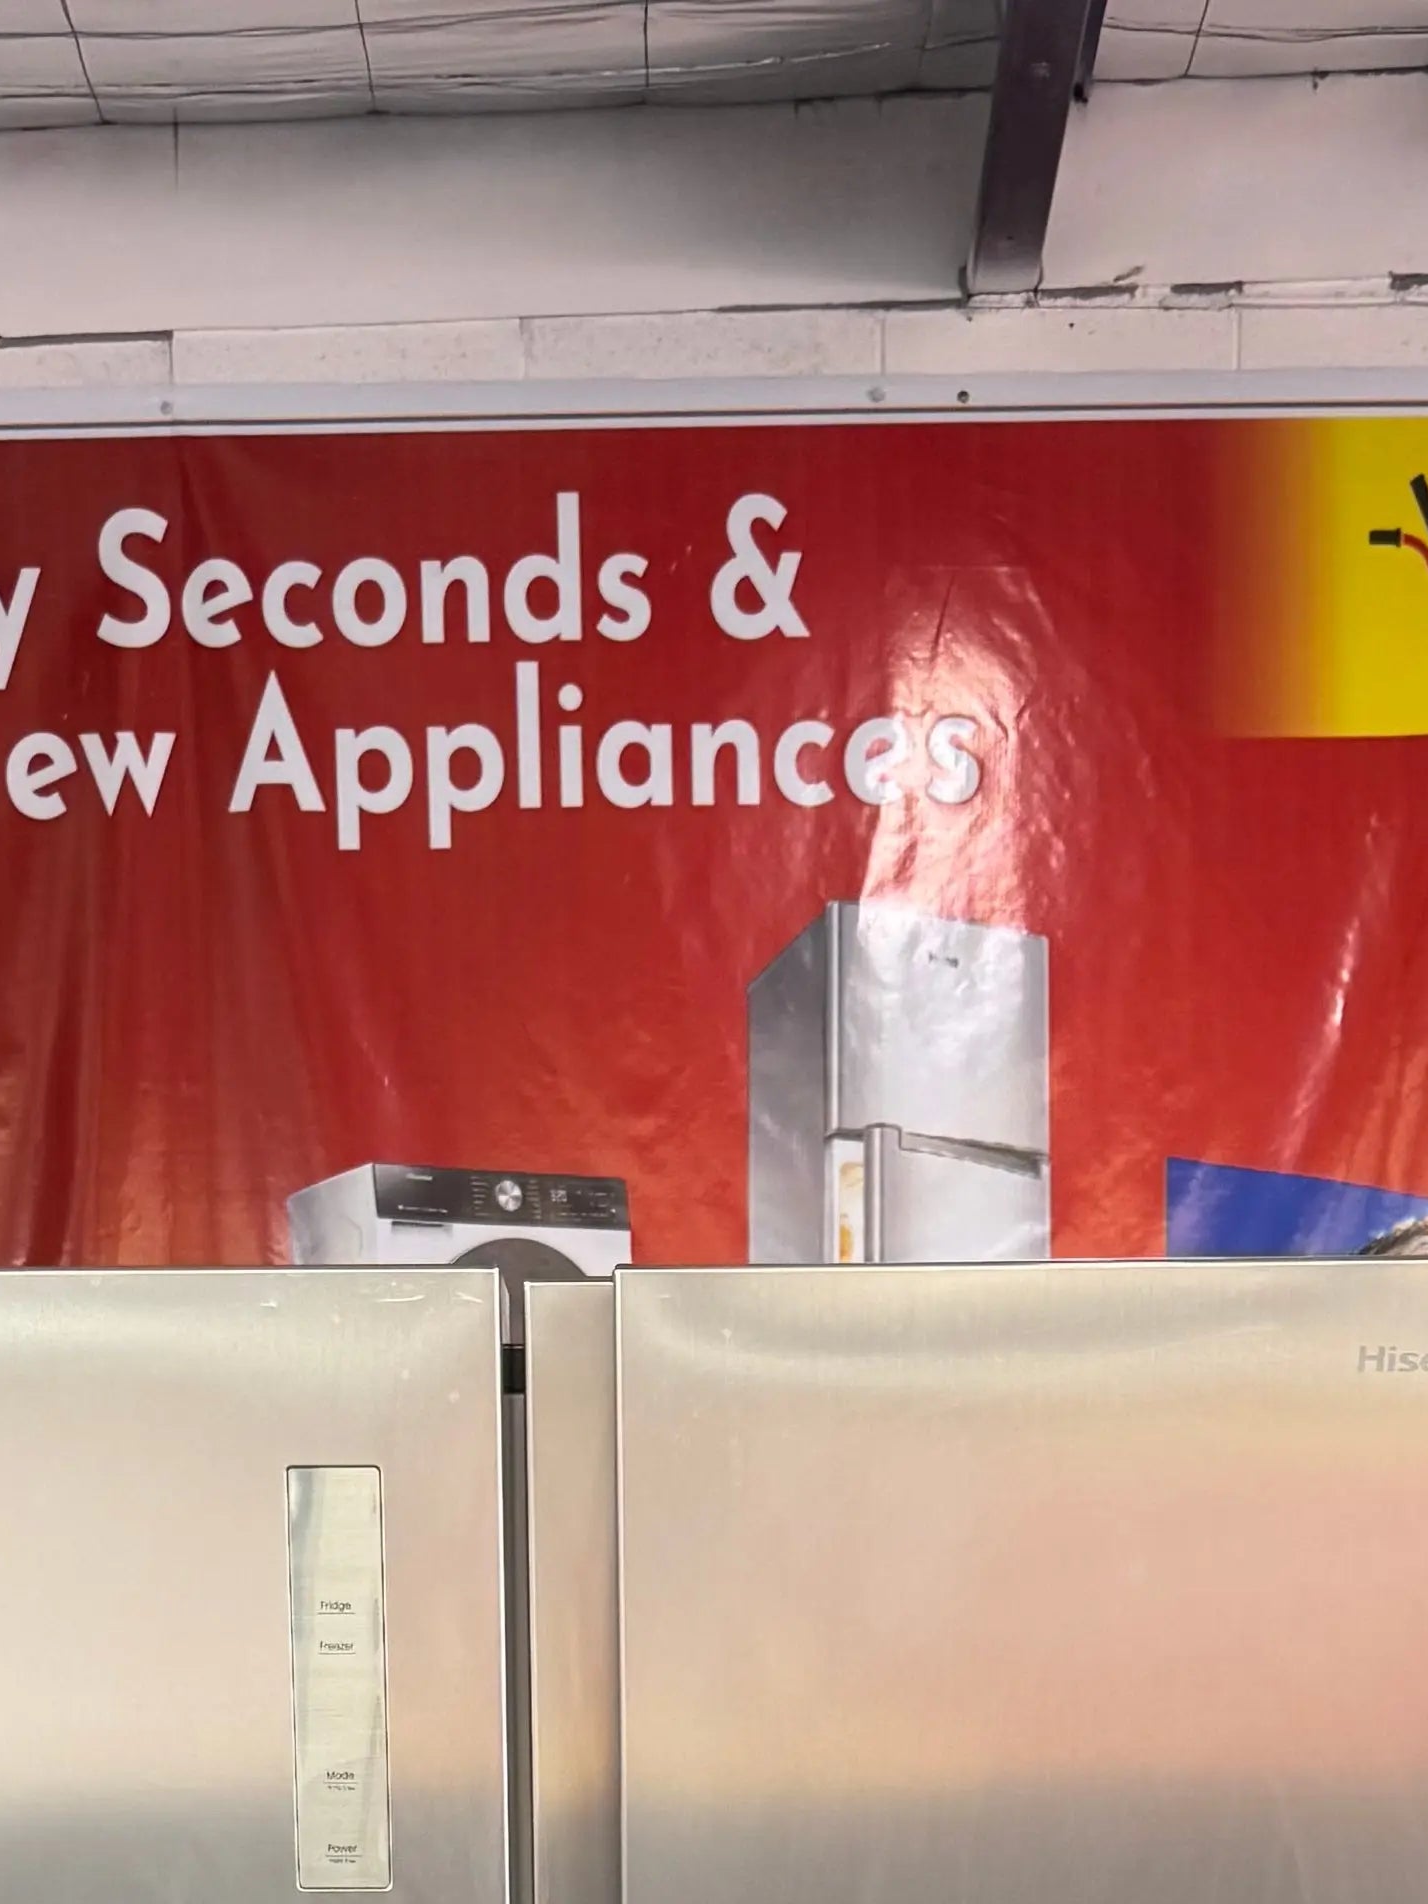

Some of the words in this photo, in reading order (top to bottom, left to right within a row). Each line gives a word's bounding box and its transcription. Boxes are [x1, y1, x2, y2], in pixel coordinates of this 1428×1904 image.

[95, 491, 650, 651] Seconds
[709, 494, 809, 641] &
[230, 663, 981, 850] Appliances
[320, 1600, 352, 1613] Fridge
